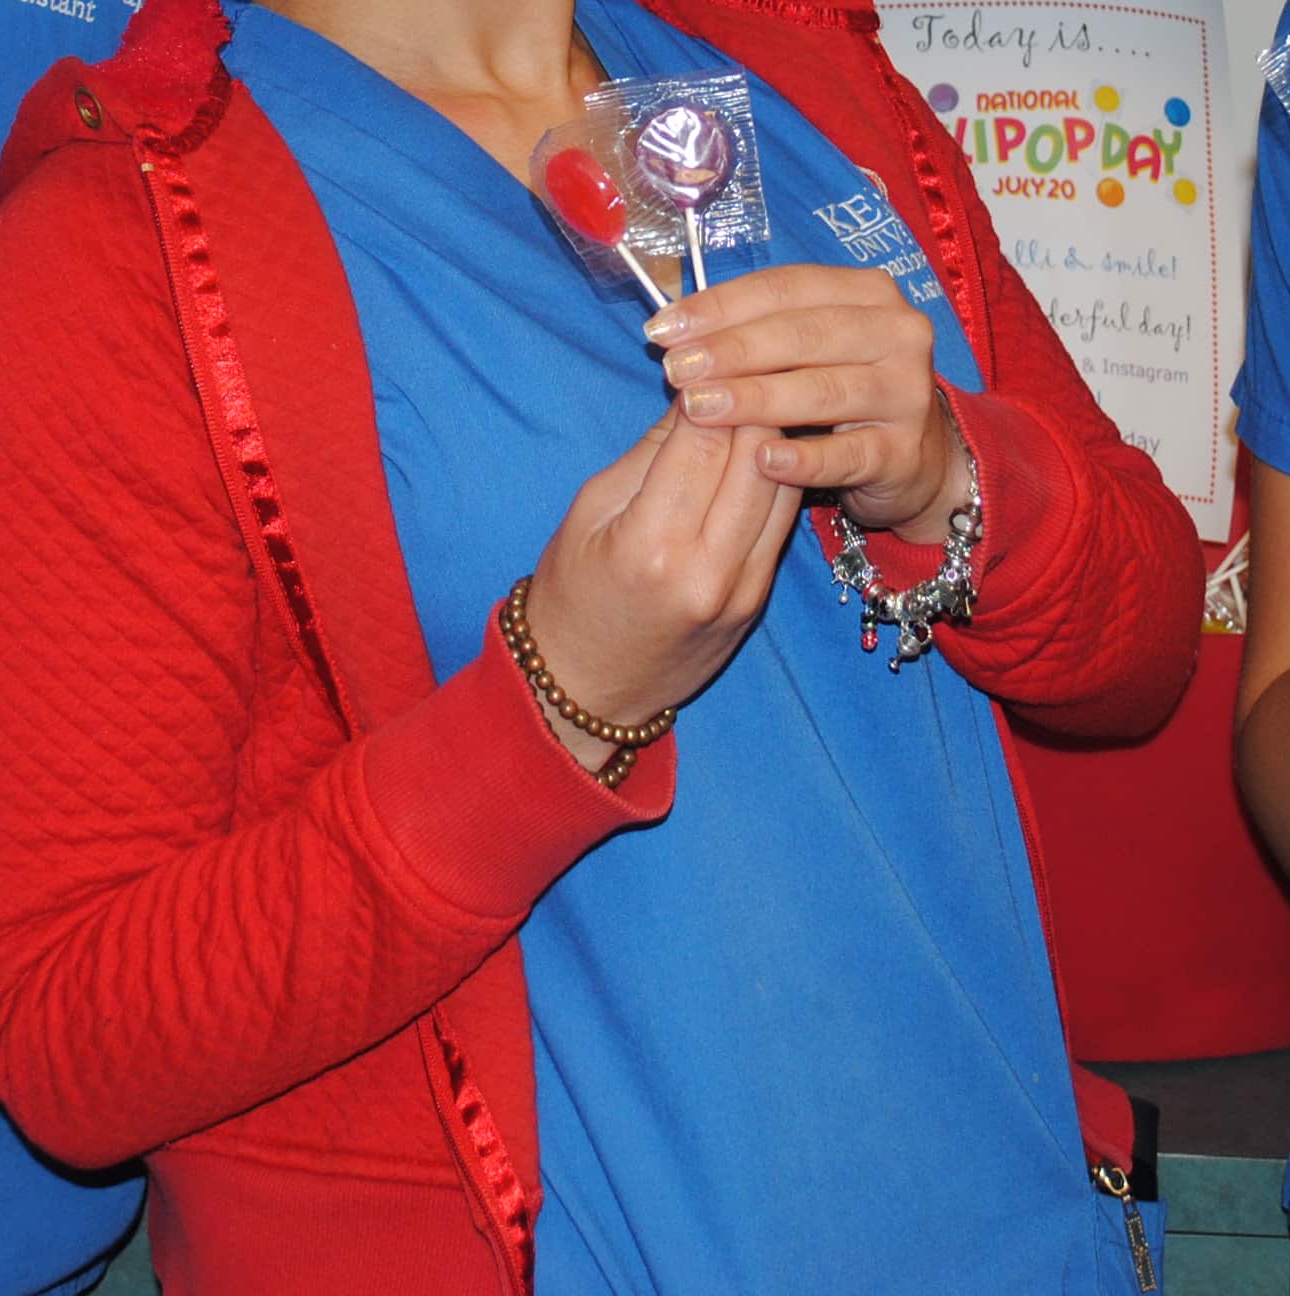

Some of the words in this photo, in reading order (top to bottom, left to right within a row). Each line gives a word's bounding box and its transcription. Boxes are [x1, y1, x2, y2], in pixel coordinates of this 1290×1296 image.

[911, 8, 1039, 68] Today
[975, 90, 1081, 113] NATIONAL
[1100, 121, 1183, 184] DAY
[992, 175, 1046, 199] JULY
[1046, 178, 1078, 202] 20
[1046, 297, 1131, 344] derful
[1102, 358, 1190, 384] Instagram
